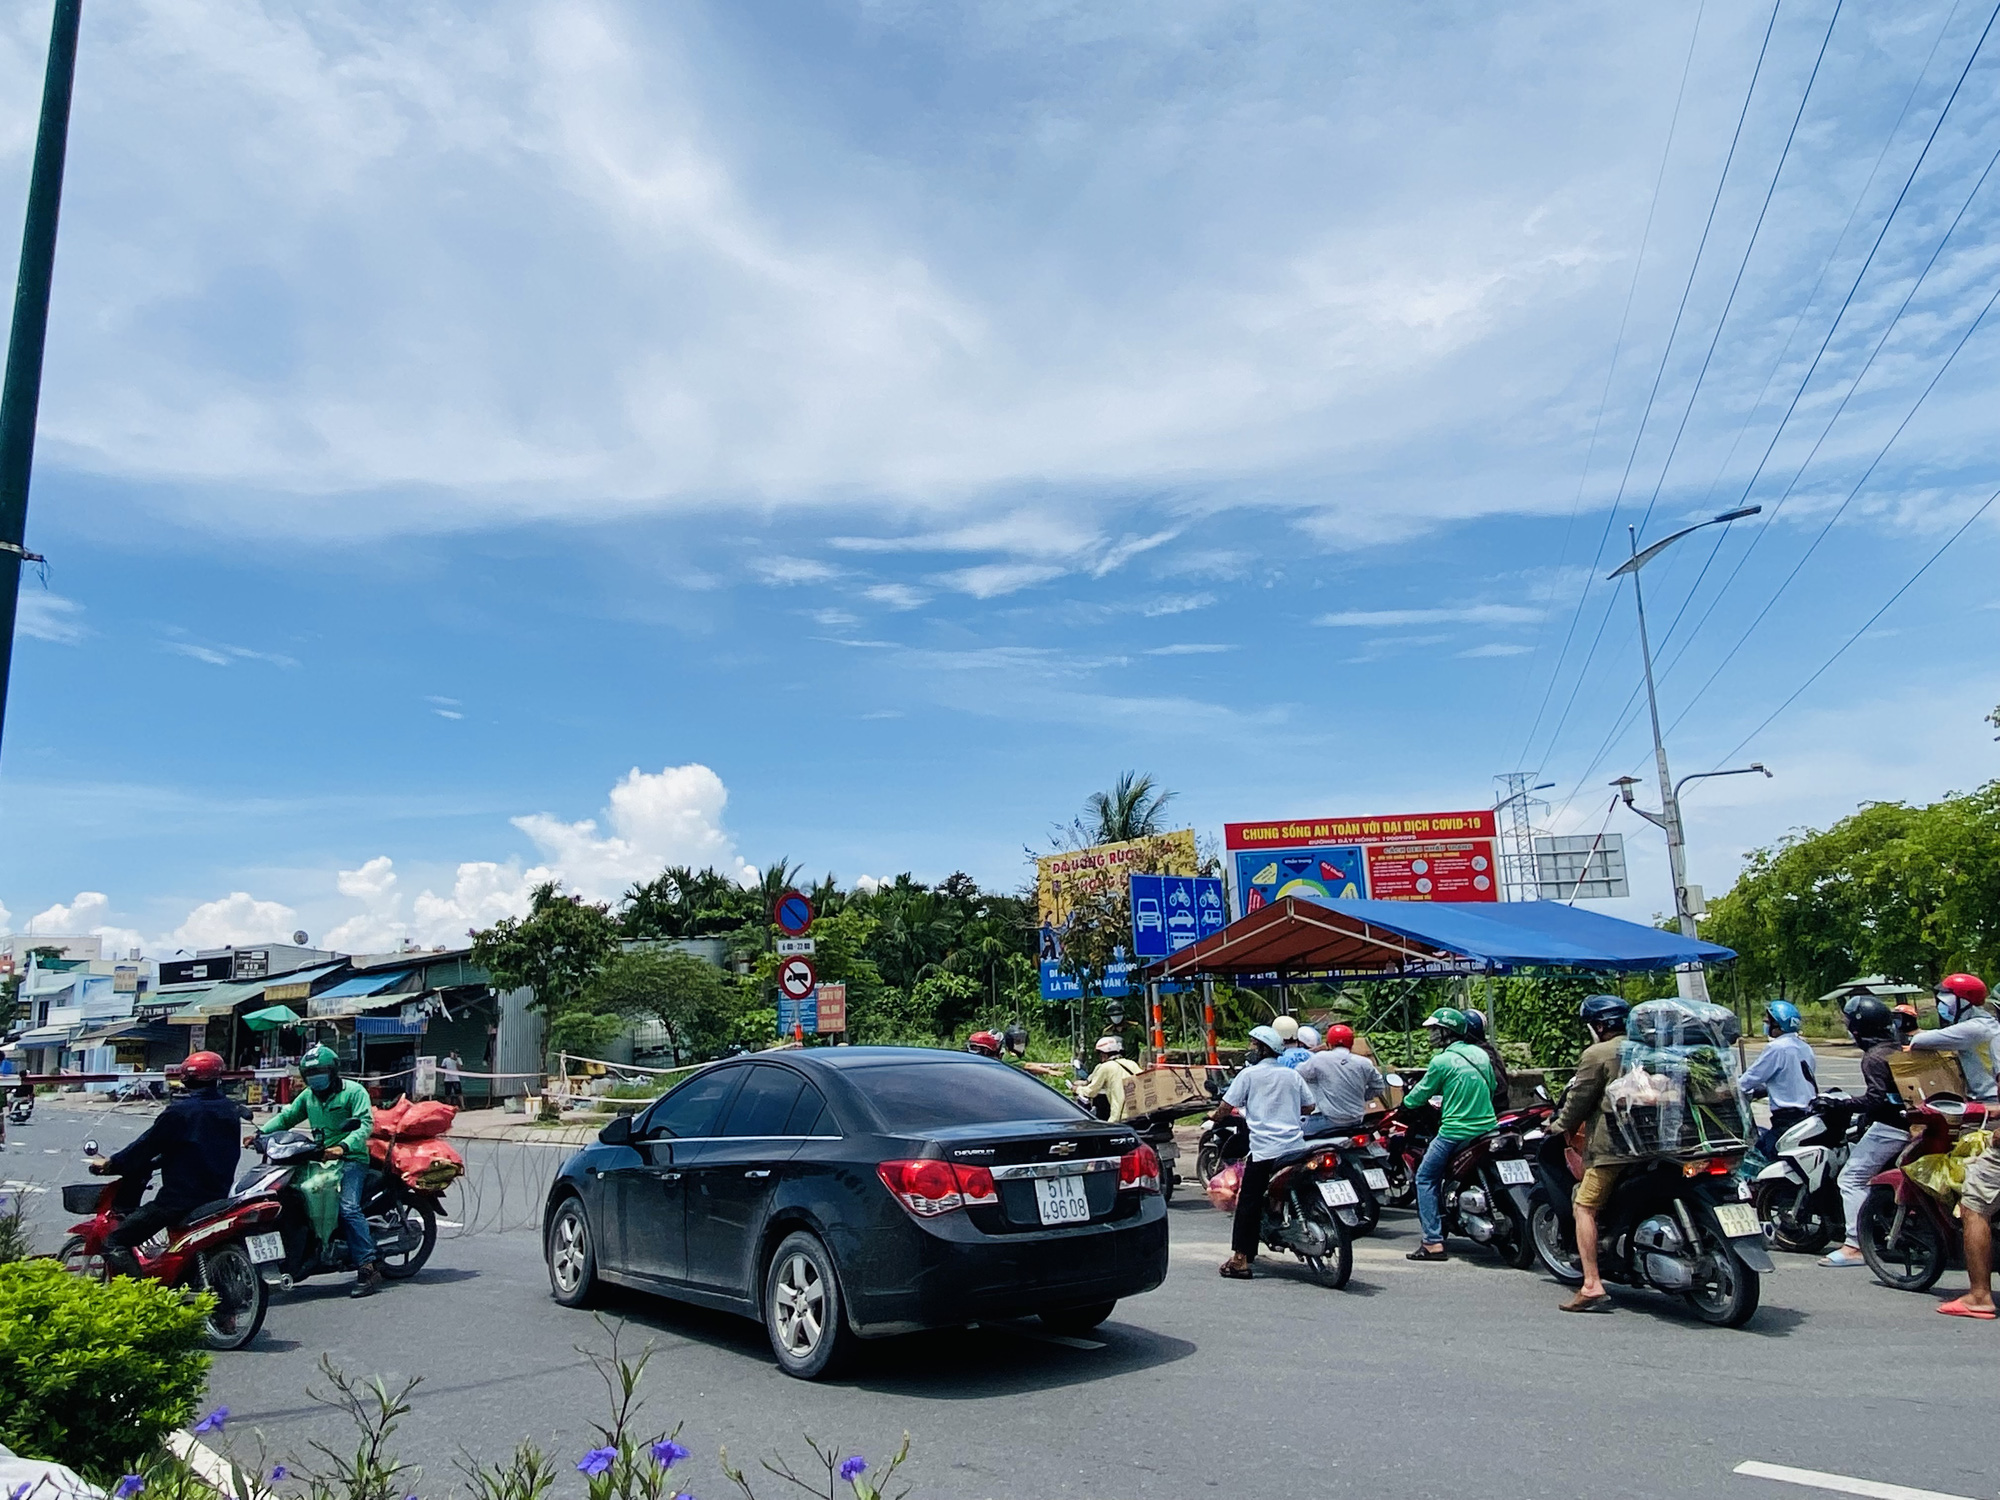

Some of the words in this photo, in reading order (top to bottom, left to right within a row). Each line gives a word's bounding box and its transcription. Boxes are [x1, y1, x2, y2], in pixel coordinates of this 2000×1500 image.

[1242, 828, 1280, 840] CHUNG
[1282, 823, 1311, 838] SỐNG
[1314, 825, 1329, 837] AN
[1331, 821, 1360, 836] TOÀN
[1362, 820, 1381, 834] VỚI
[1383, 820, 1401, 834] ĐẠI
[1404, 819, 1430, 833] DỊCH
[1432, 816, 1481, 830] COVID-19
